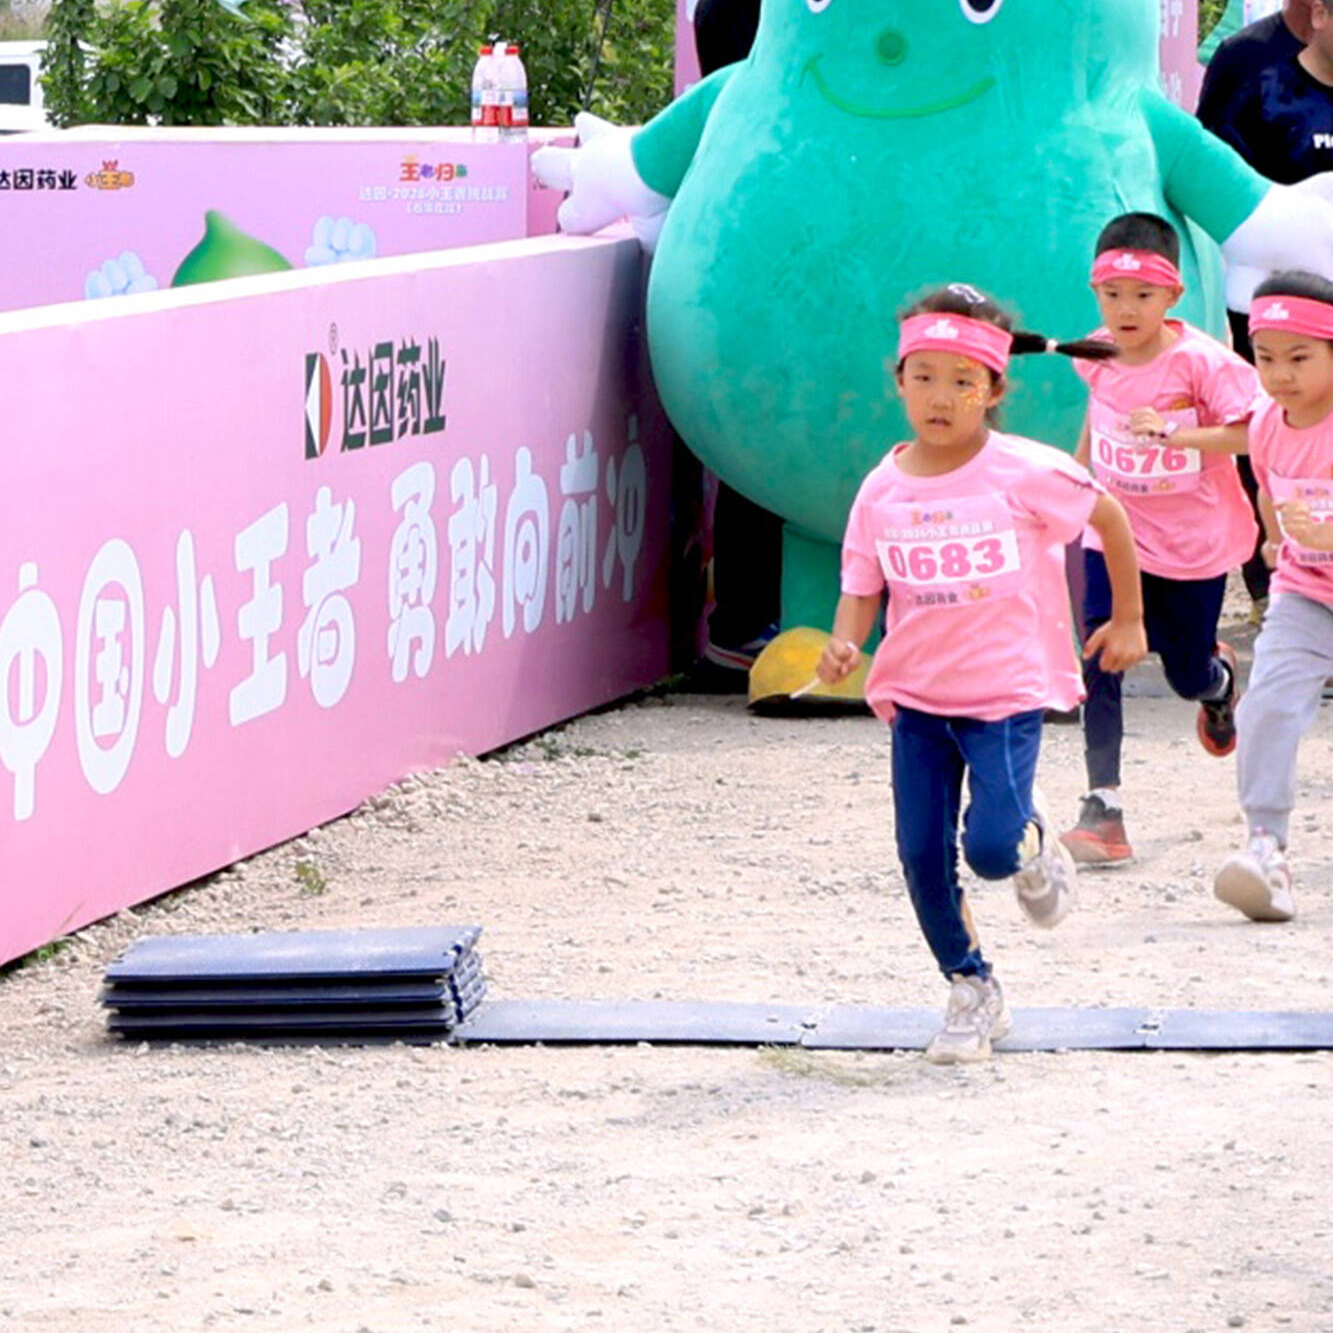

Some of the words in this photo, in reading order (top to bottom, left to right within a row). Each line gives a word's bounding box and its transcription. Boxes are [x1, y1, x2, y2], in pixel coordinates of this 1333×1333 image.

[341, 336, 446, 452] 达因药业
[1100, 446, 1187, 473] 0676
[888, 538, 1005, 581] 0683
[0, 486, 361, 821] 中国小王者
[387, 414, 646, 683] 勇敢向前冲
